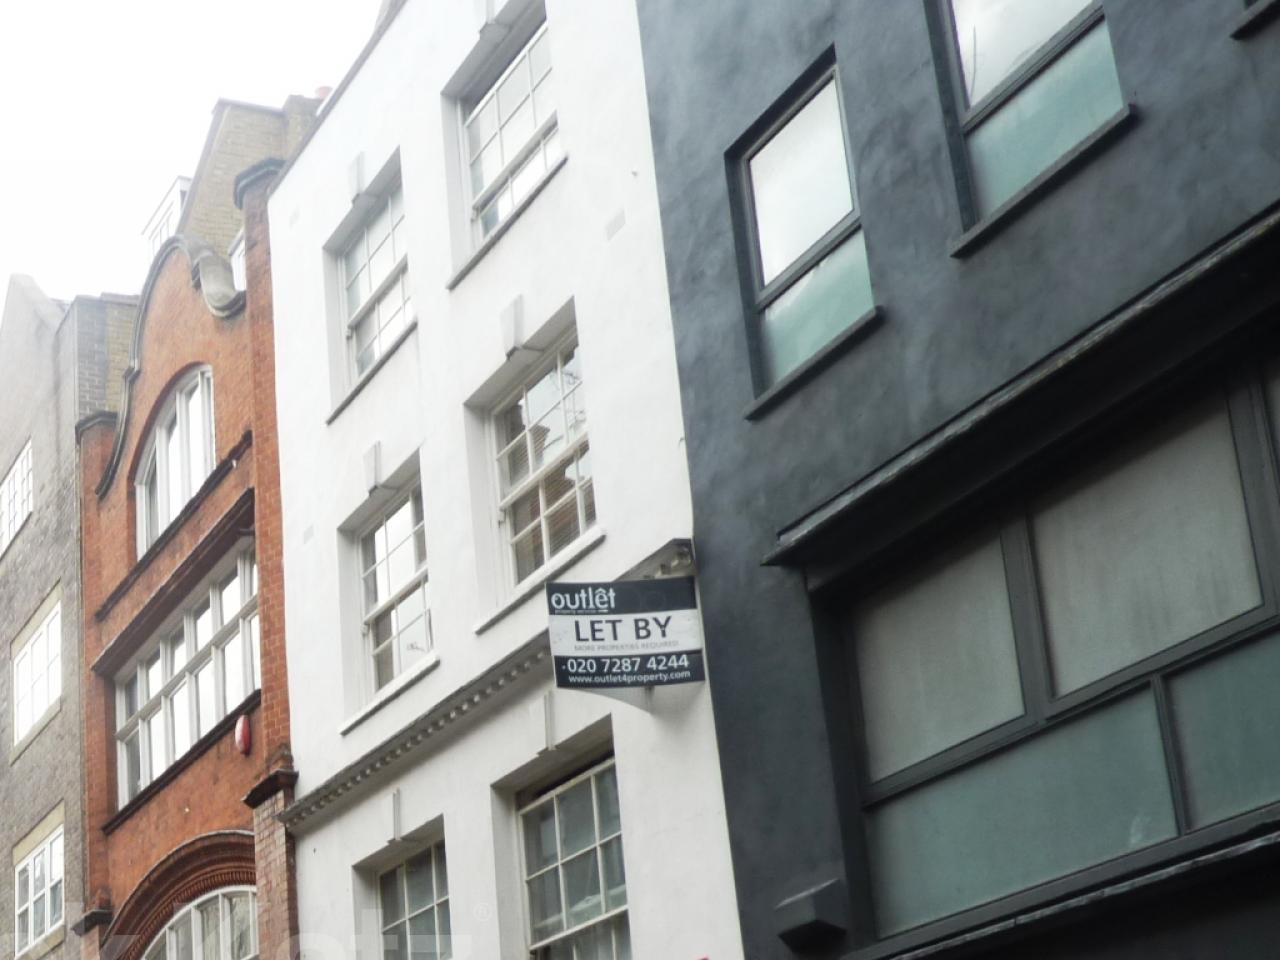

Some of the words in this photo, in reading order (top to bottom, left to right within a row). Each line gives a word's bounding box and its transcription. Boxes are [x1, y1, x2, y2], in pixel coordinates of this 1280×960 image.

[574, 619, 622, 642] LET
[634, 616, 672, 640] BY
[567, 658, 596, 673] 020
[601, 657, 640, 672] 7287
[646, 654, 690, 671] 4244
[568, 670, 690, 684] www.outlet4property.com
